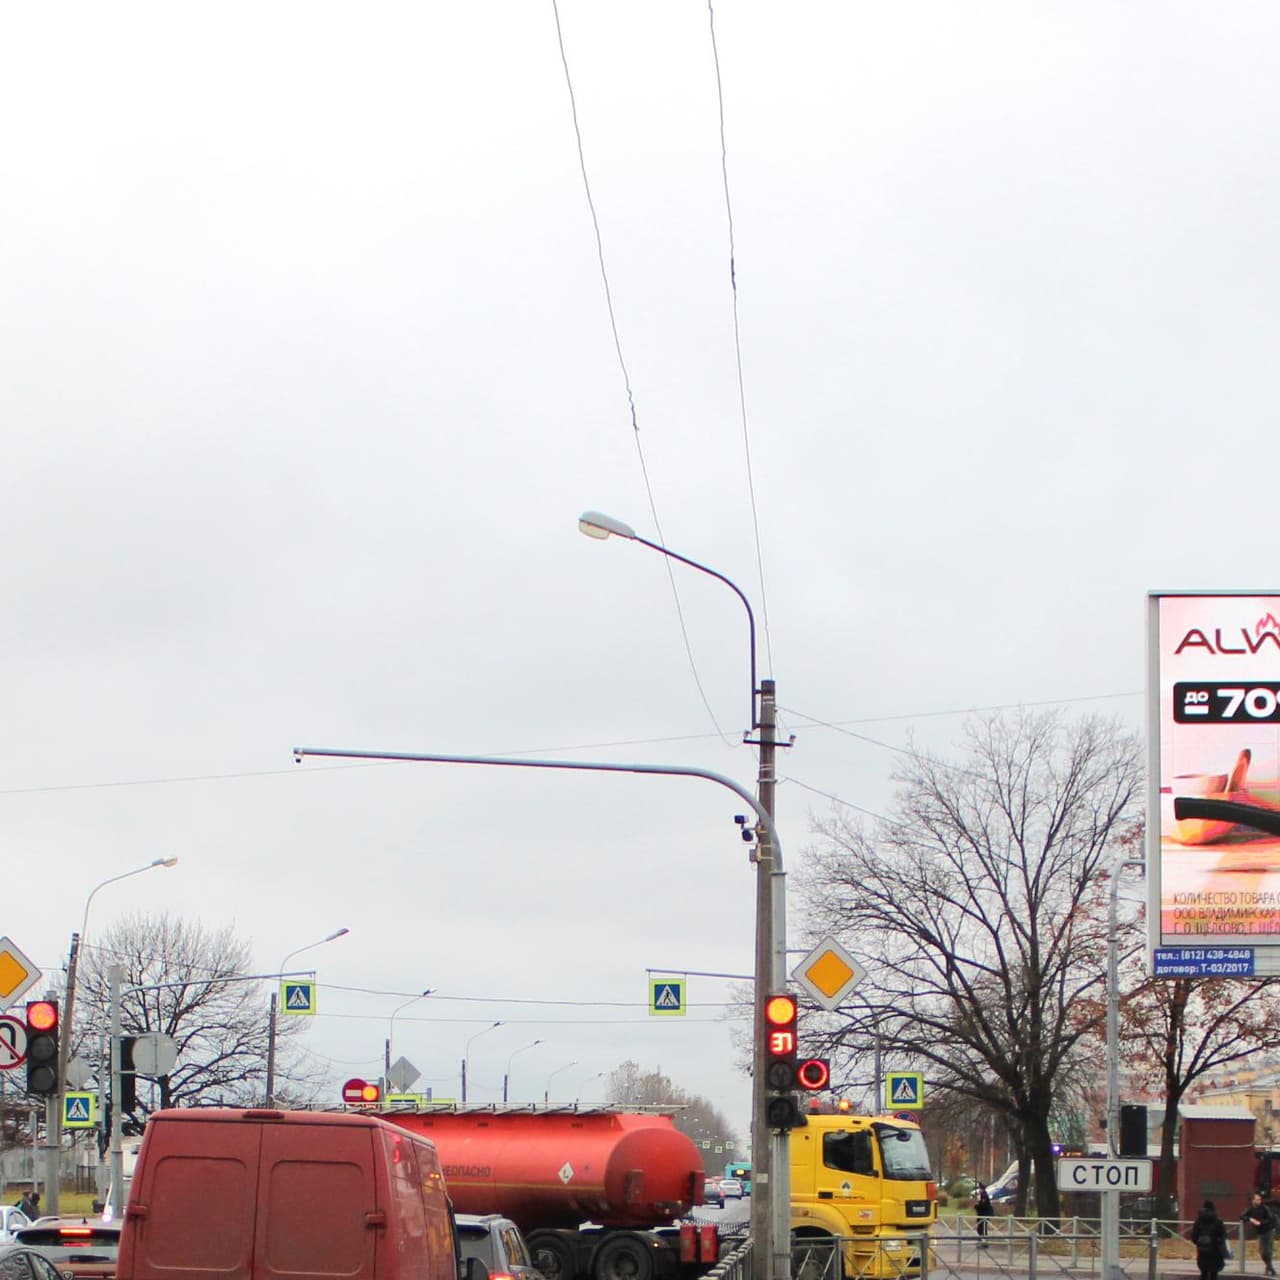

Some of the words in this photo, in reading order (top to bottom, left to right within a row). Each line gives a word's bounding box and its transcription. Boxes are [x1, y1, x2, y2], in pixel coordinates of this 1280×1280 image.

[1174, 891, 1237, 905] КОЛИЧЕСТВО
[1239, 891, 1275, 905] ТОВАРА
[1174, 907, 1195, 919] ООО
[1198, 907, 1275, 920] ВЛАДИМИРСКАЯ
[1181, 950, 1205, 960] (812)
[1206, 950, 1251, 959] 438-4848
[1156, 966, 1199, 975] договор:
[1073, 1165, 1138, 1186] СТОП
